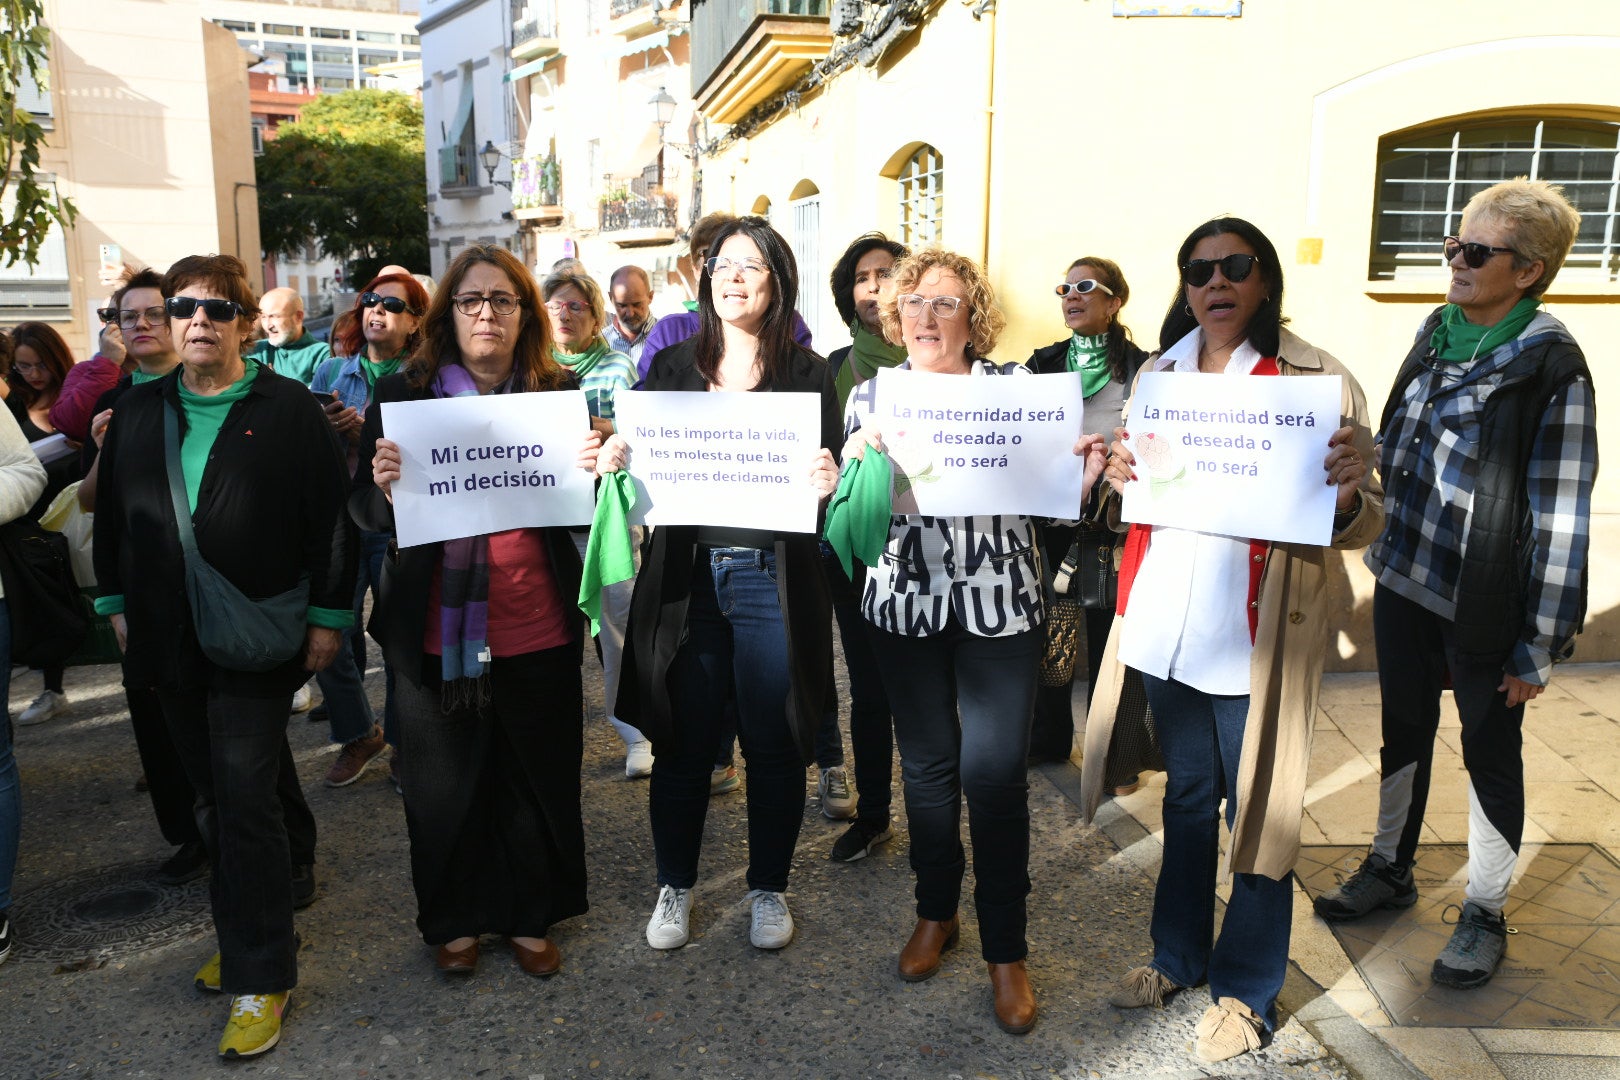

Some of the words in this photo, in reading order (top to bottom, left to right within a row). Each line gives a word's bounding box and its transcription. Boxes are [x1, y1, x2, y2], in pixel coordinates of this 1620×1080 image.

[1095, 332, 1109, 348] LE
[893, 403, 912, 418] La
[918, 408, 1022, 422] maternidad
[1028, 407, 1065, 421] será
[1144, 405, 1160, 420] La
[1165, 409, 1269, 425] maternidad
[1275, 411, 1315, 427] será
[636, 427, 656, 438] No
[661, 427, 680, 438] les
[685, 428, 743, 442] importa
[748, 429, 761, 440] la
[766, 429, 800, 442] vida,
[933, 431, 1006, 445] deseada
[1012, 435, 1022, 445] o
[1182, 433, 1256, 450] deseada
[1262, 439, 1272, 451] o
[432, 446, 458, 464] Mi
[466, 444, 543, 463] cuerpo
[650, 448, 670, 459] les
[674, 449, 732, 461] molesta
[737, 453, 763, 464] que
[768, 452, 788, 463] las
[944, 457, 966, 468] no
[971, 455, 1008, 468] será
[1196, 459, 1217, 472] no
[1223, 462, 1258, 477] será
[429, 476, 457, 496] mi
[464, 470, 556, 491] decisión
[650, 470, 708, 484] mujeres
[712, 471, 790, 484] decidamos
